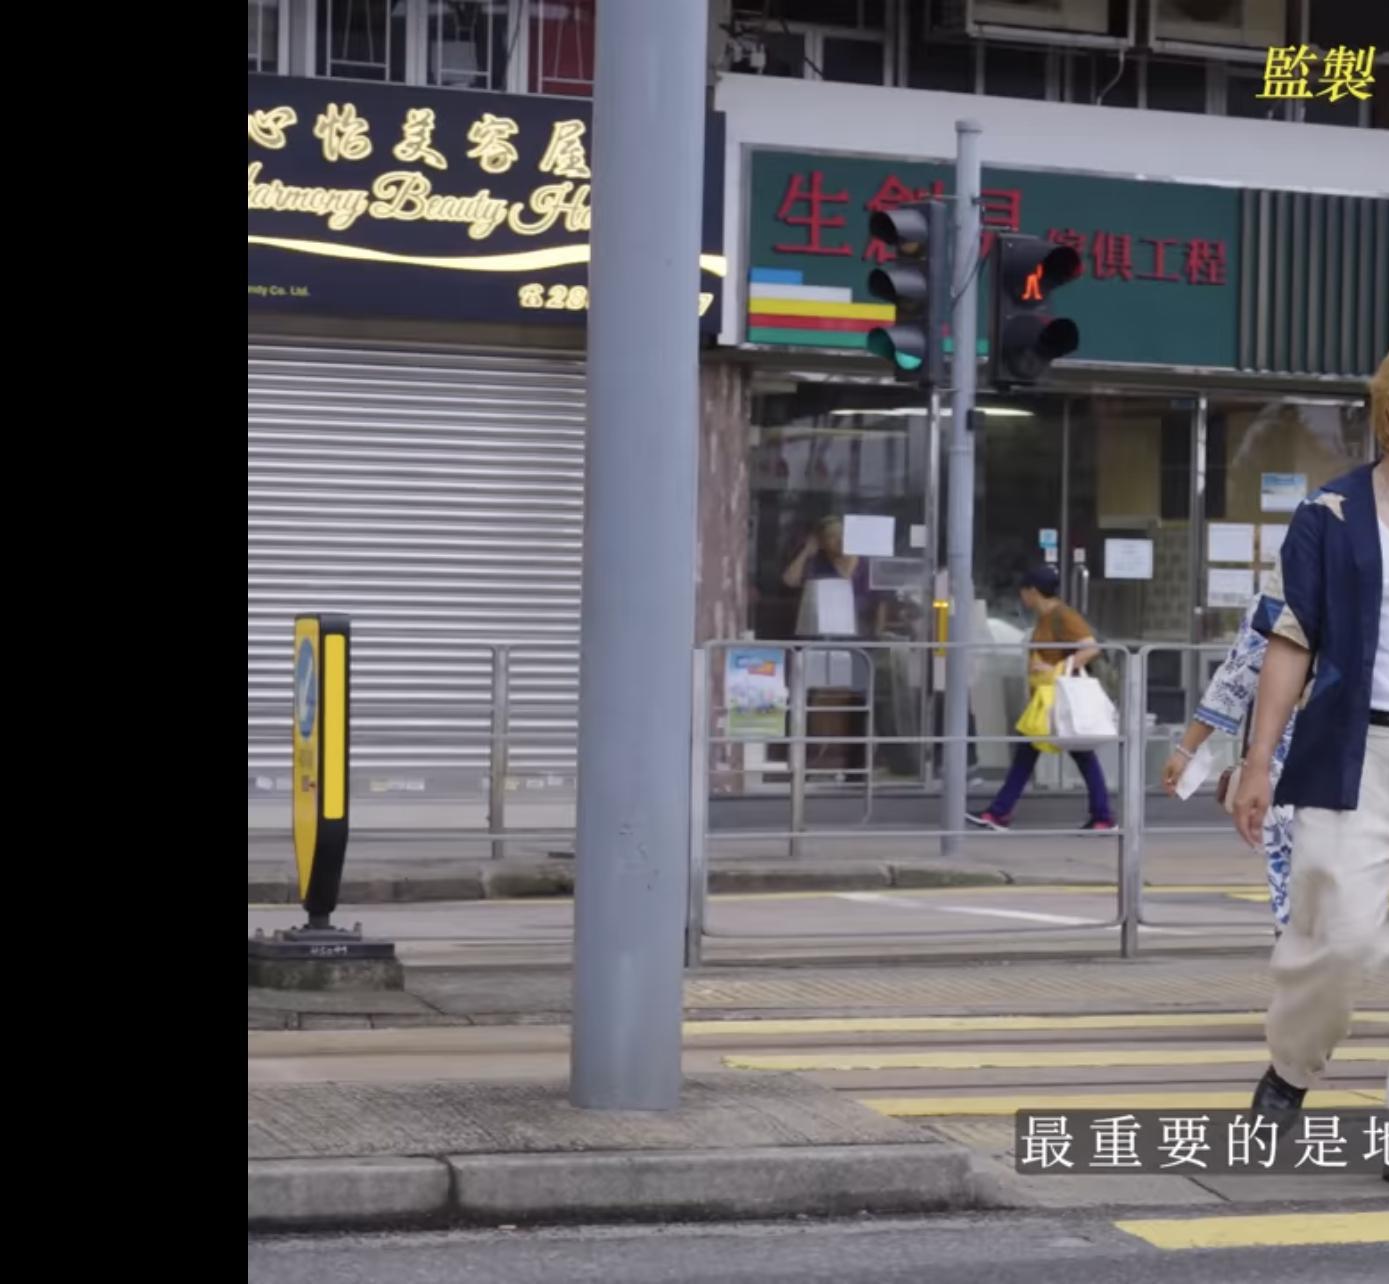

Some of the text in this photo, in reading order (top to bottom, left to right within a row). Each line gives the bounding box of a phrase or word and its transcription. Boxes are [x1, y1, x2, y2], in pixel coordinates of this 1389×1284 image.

[248, 102, 592, 178] 心怡美容屋
[369, 171, 509, 239] Beauty
